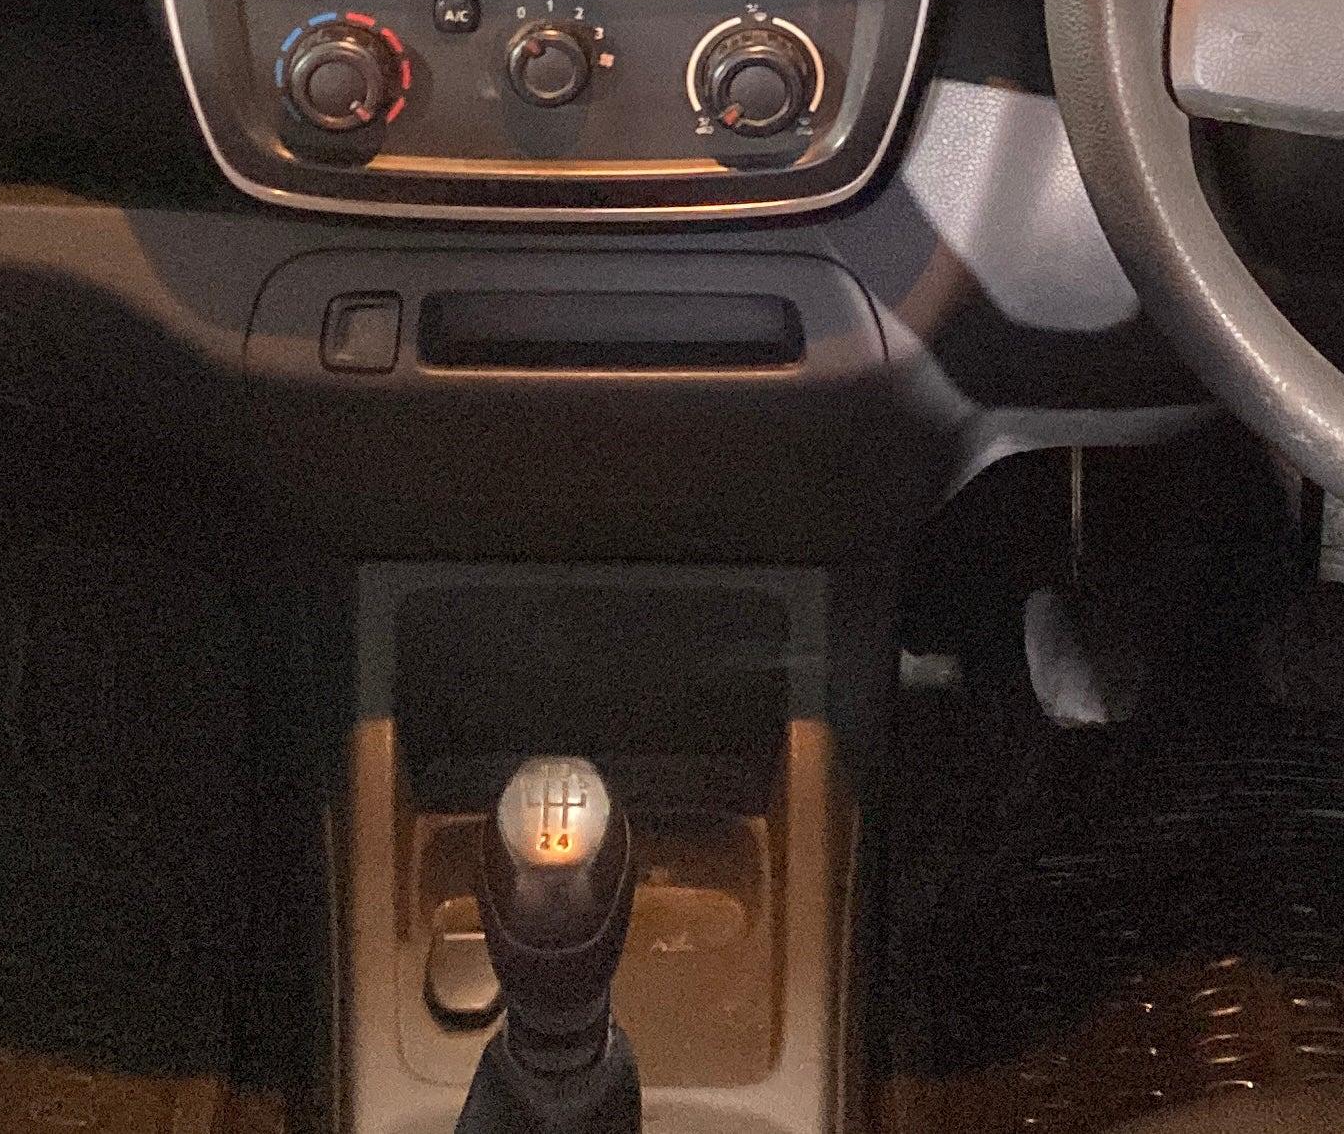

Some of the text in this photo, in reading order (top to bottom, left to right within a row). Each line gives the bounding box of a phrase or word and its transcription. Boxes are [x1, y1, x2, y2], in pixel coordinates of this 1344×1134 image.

[517, 6, 527, 19] 0
[547, 0, 554, 12] 1
[444, 9, 469, 23] A/C
[574, 7, 584, 20] 2
[594, 27, 604, 40] 3
[540, 833, 569, 850] 2 4
